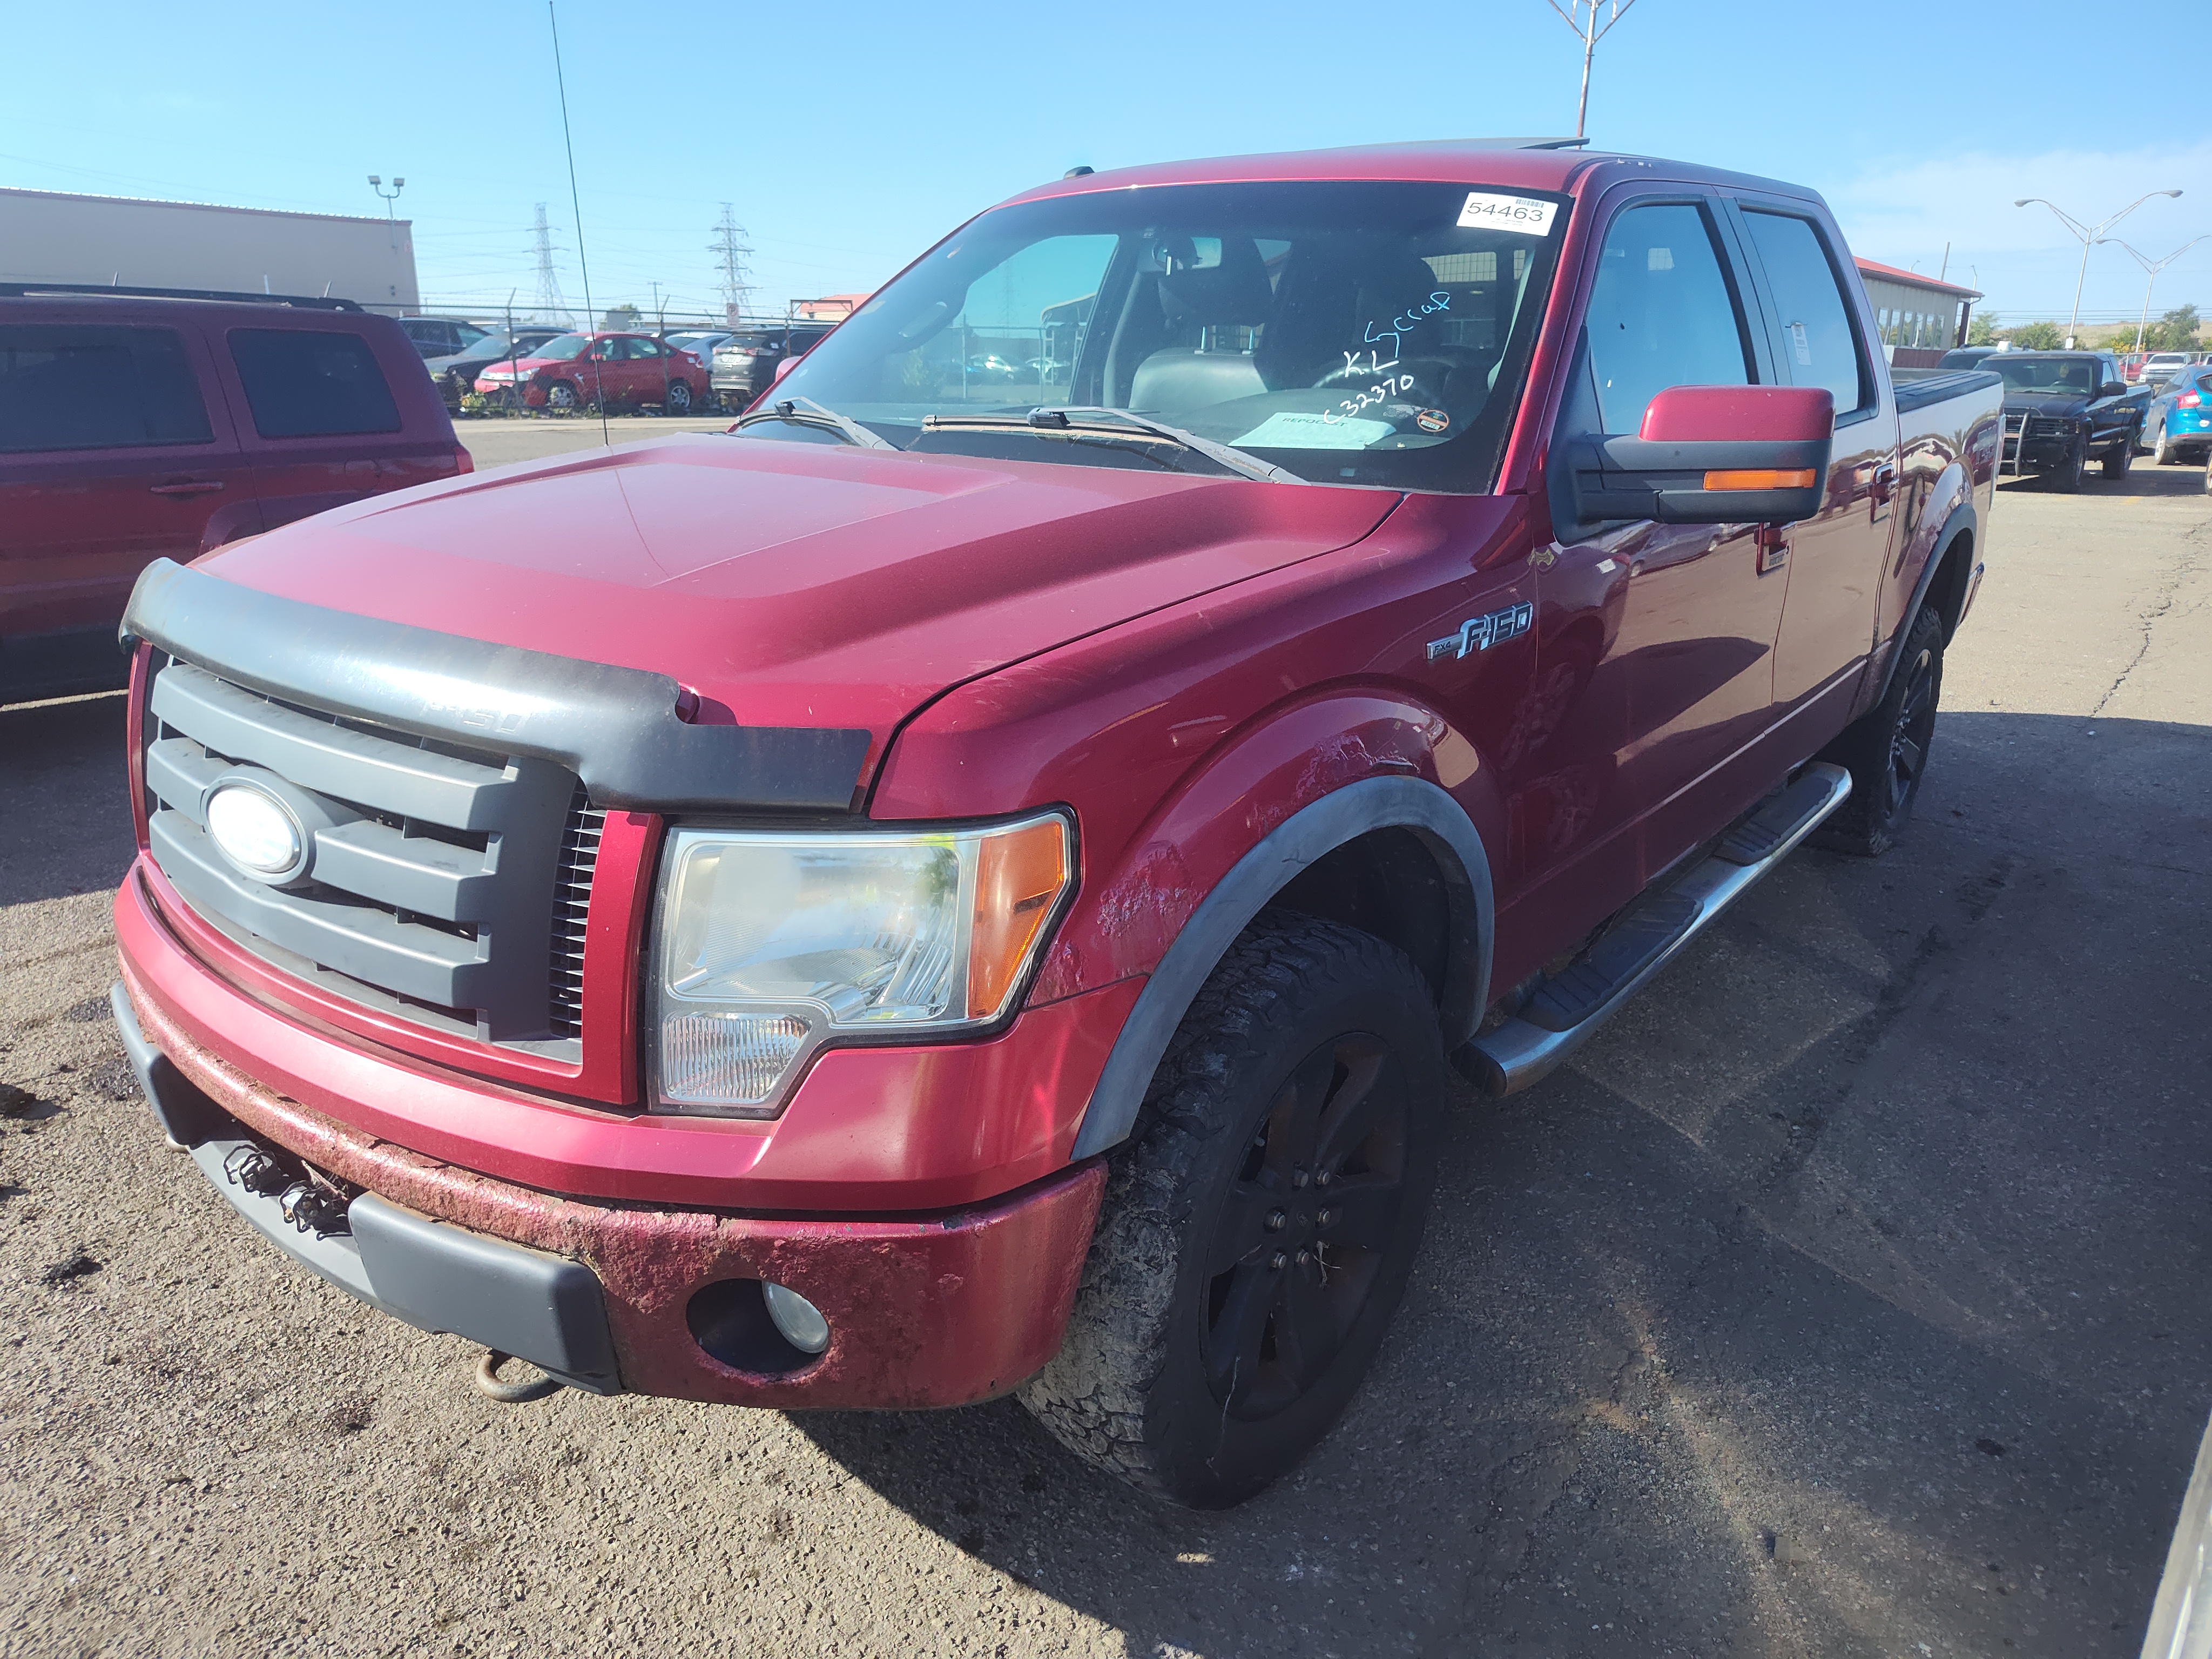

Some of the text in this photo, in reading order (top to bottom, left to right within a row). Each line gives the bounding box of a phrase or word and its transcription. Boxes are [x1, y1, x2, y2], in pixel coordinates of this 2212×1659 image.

[1467, 202, 1543, 221] 54463
[1323, 374, 1414, 424] C32370
[1434, 640, 1452, 655] FX4
